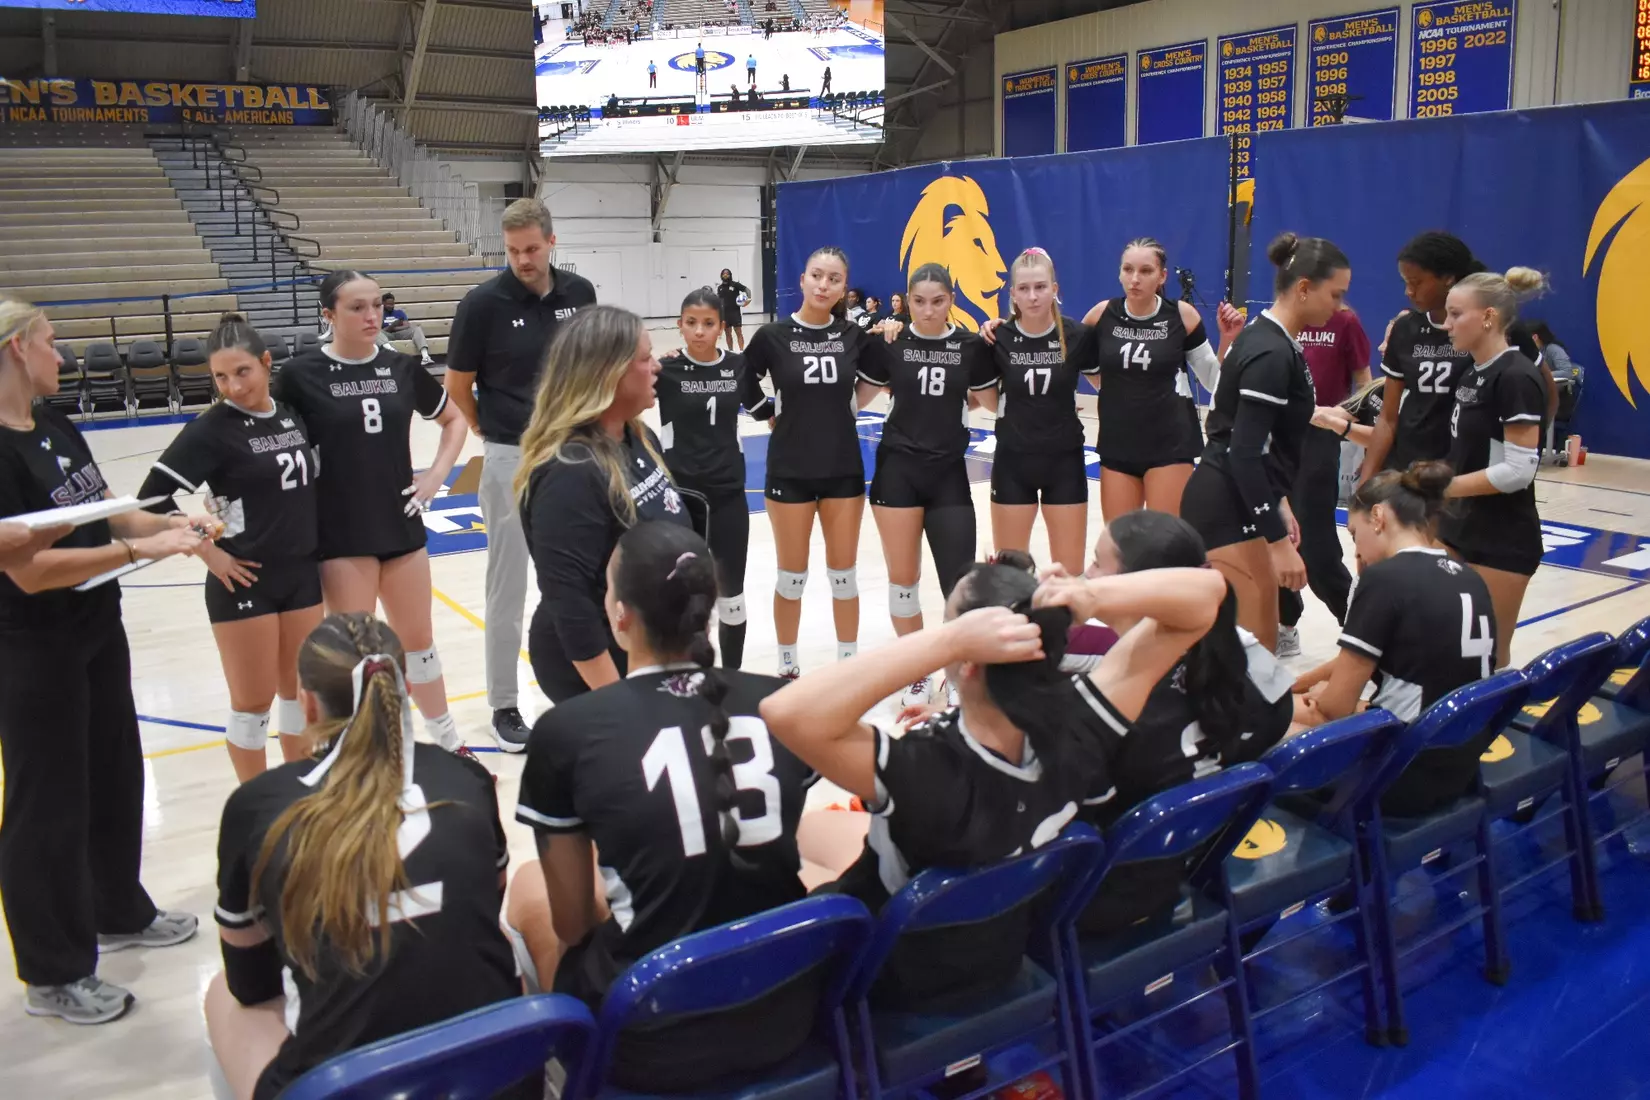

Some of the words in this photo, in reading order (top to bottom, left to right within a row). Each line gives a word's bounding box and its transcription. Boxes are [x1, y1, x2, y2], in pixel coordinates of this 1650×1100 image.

[1436, 7, 1511, 26] BASKETBALL
[1454, 2, 1493, 14] MEN'S
[1329, 23, 1395, 40] BASKETBALL
[1345, 18, 1379, 30] MEN'S
[1418, 28, 1444, 40] NCAA
[1446, 20, 1508, 35] TOURNAMENT
[1235, 40, 1293, 55] BASKETBALL
[1249, 34, 1279, 46] MEN'S
[1420, 37, 1458, 53] 1996
[1464, 31, 1507, 48] 2022
[1153, 60, 1174, 69] CROSS
[1175, 54, 1204, 66] COUNTRY
[1165, 49, 1192, 60] MEN'S
[1316, 52, 1349, 67] 1990
[1419, 53, 1456, 70] 1997
[1224, 66, 1252, 79] 1934
[1258, 61, 1288, 75] 1955
[1315, 67, 1348, 82] 1996
[1419, 70, 1456, 86] 1998
[1224, 80, 1252, 94] 1939
[1258, 75, 1286, 89] 1957
[1315, 82, 1347, 97] 1998
[91, 79, 330, 110] BASKETBALL
[1223, 95, 1252, 108] 1940
[1257, 90, 1287, 104] 1958
[1417, 86, 1458, 102] 2005
[10, 107, 47, 121] NCAA
[52, 107, 149, 122] TOURNAMENTS
[1223, 109, 1251, 122] 1942
[1257, 104, 1286, 119] 1964
[1416, 103, 1452, 118] 2015
[1223, 123, 1251, 135] 1948
[1256, 119, 1284, 131] 1974
[1112, 325, 1169, 340] SALUKIS
[790, 340, 845, 353] SALUKIS
[903, 348, 962, 365] SALUKIS
[1120, 341, 1152, 371] 14
[803, 355, 838, 384] 20
[1417, 360, 1453, 393] 22
[329, 378, 398, 397] SALUKIS
[681, 379, 738, 393] SALUKIS
[917, 366, 946, 397] 18
[1024, 367, 1052, 396] 17
[361, 398, 383, 433] 8
[706, 395, 717, 426] 1
[248, 429, 306, 453] SALUKIS
[276, 449, 308, 491] 21
[1459, 593, 1494, 680] 4
[641, 715, 784, 858] 13
